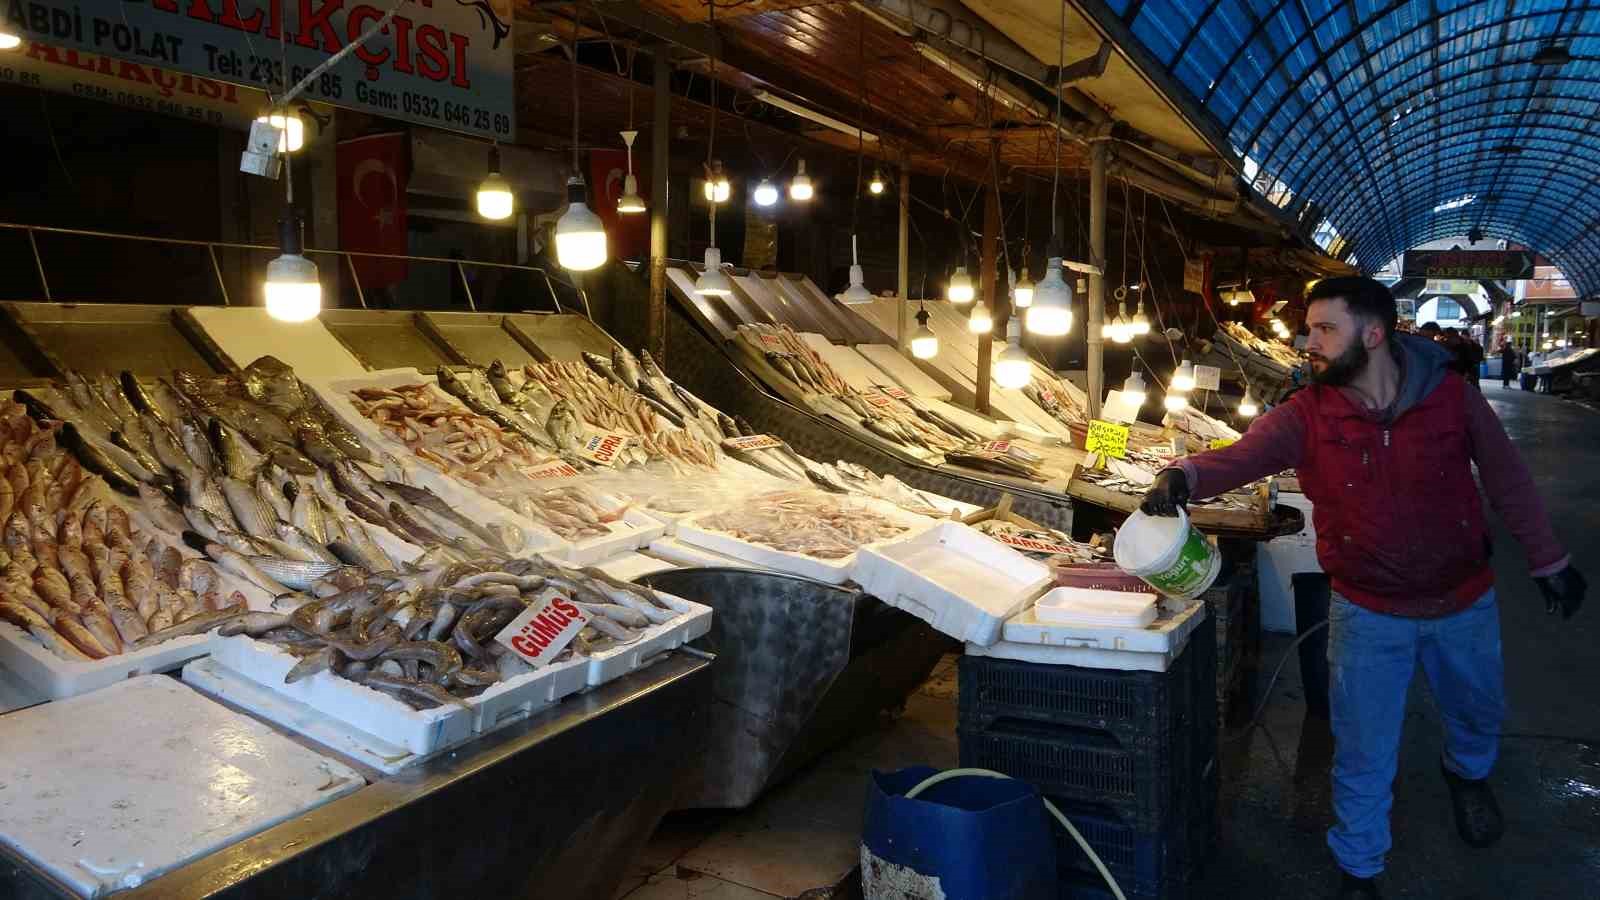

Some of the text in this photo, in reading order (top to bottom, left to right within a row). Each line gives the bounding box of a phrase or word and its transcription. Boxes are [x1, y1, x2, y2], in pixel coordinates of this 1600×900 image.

[93, 18, 184, 64] POLAT
[203, 43, 243, 78] Tel:
[249, 55, 283, 86] 233
[320, 74, 342, 98] 85
[355, 80, 398, 110] Gsm:
[402, 92, 440, 119] 0532
[444, 101, 471, 126] 646
[474, 108, 490, 130] 25
[494, 112, 511, 134] 69
